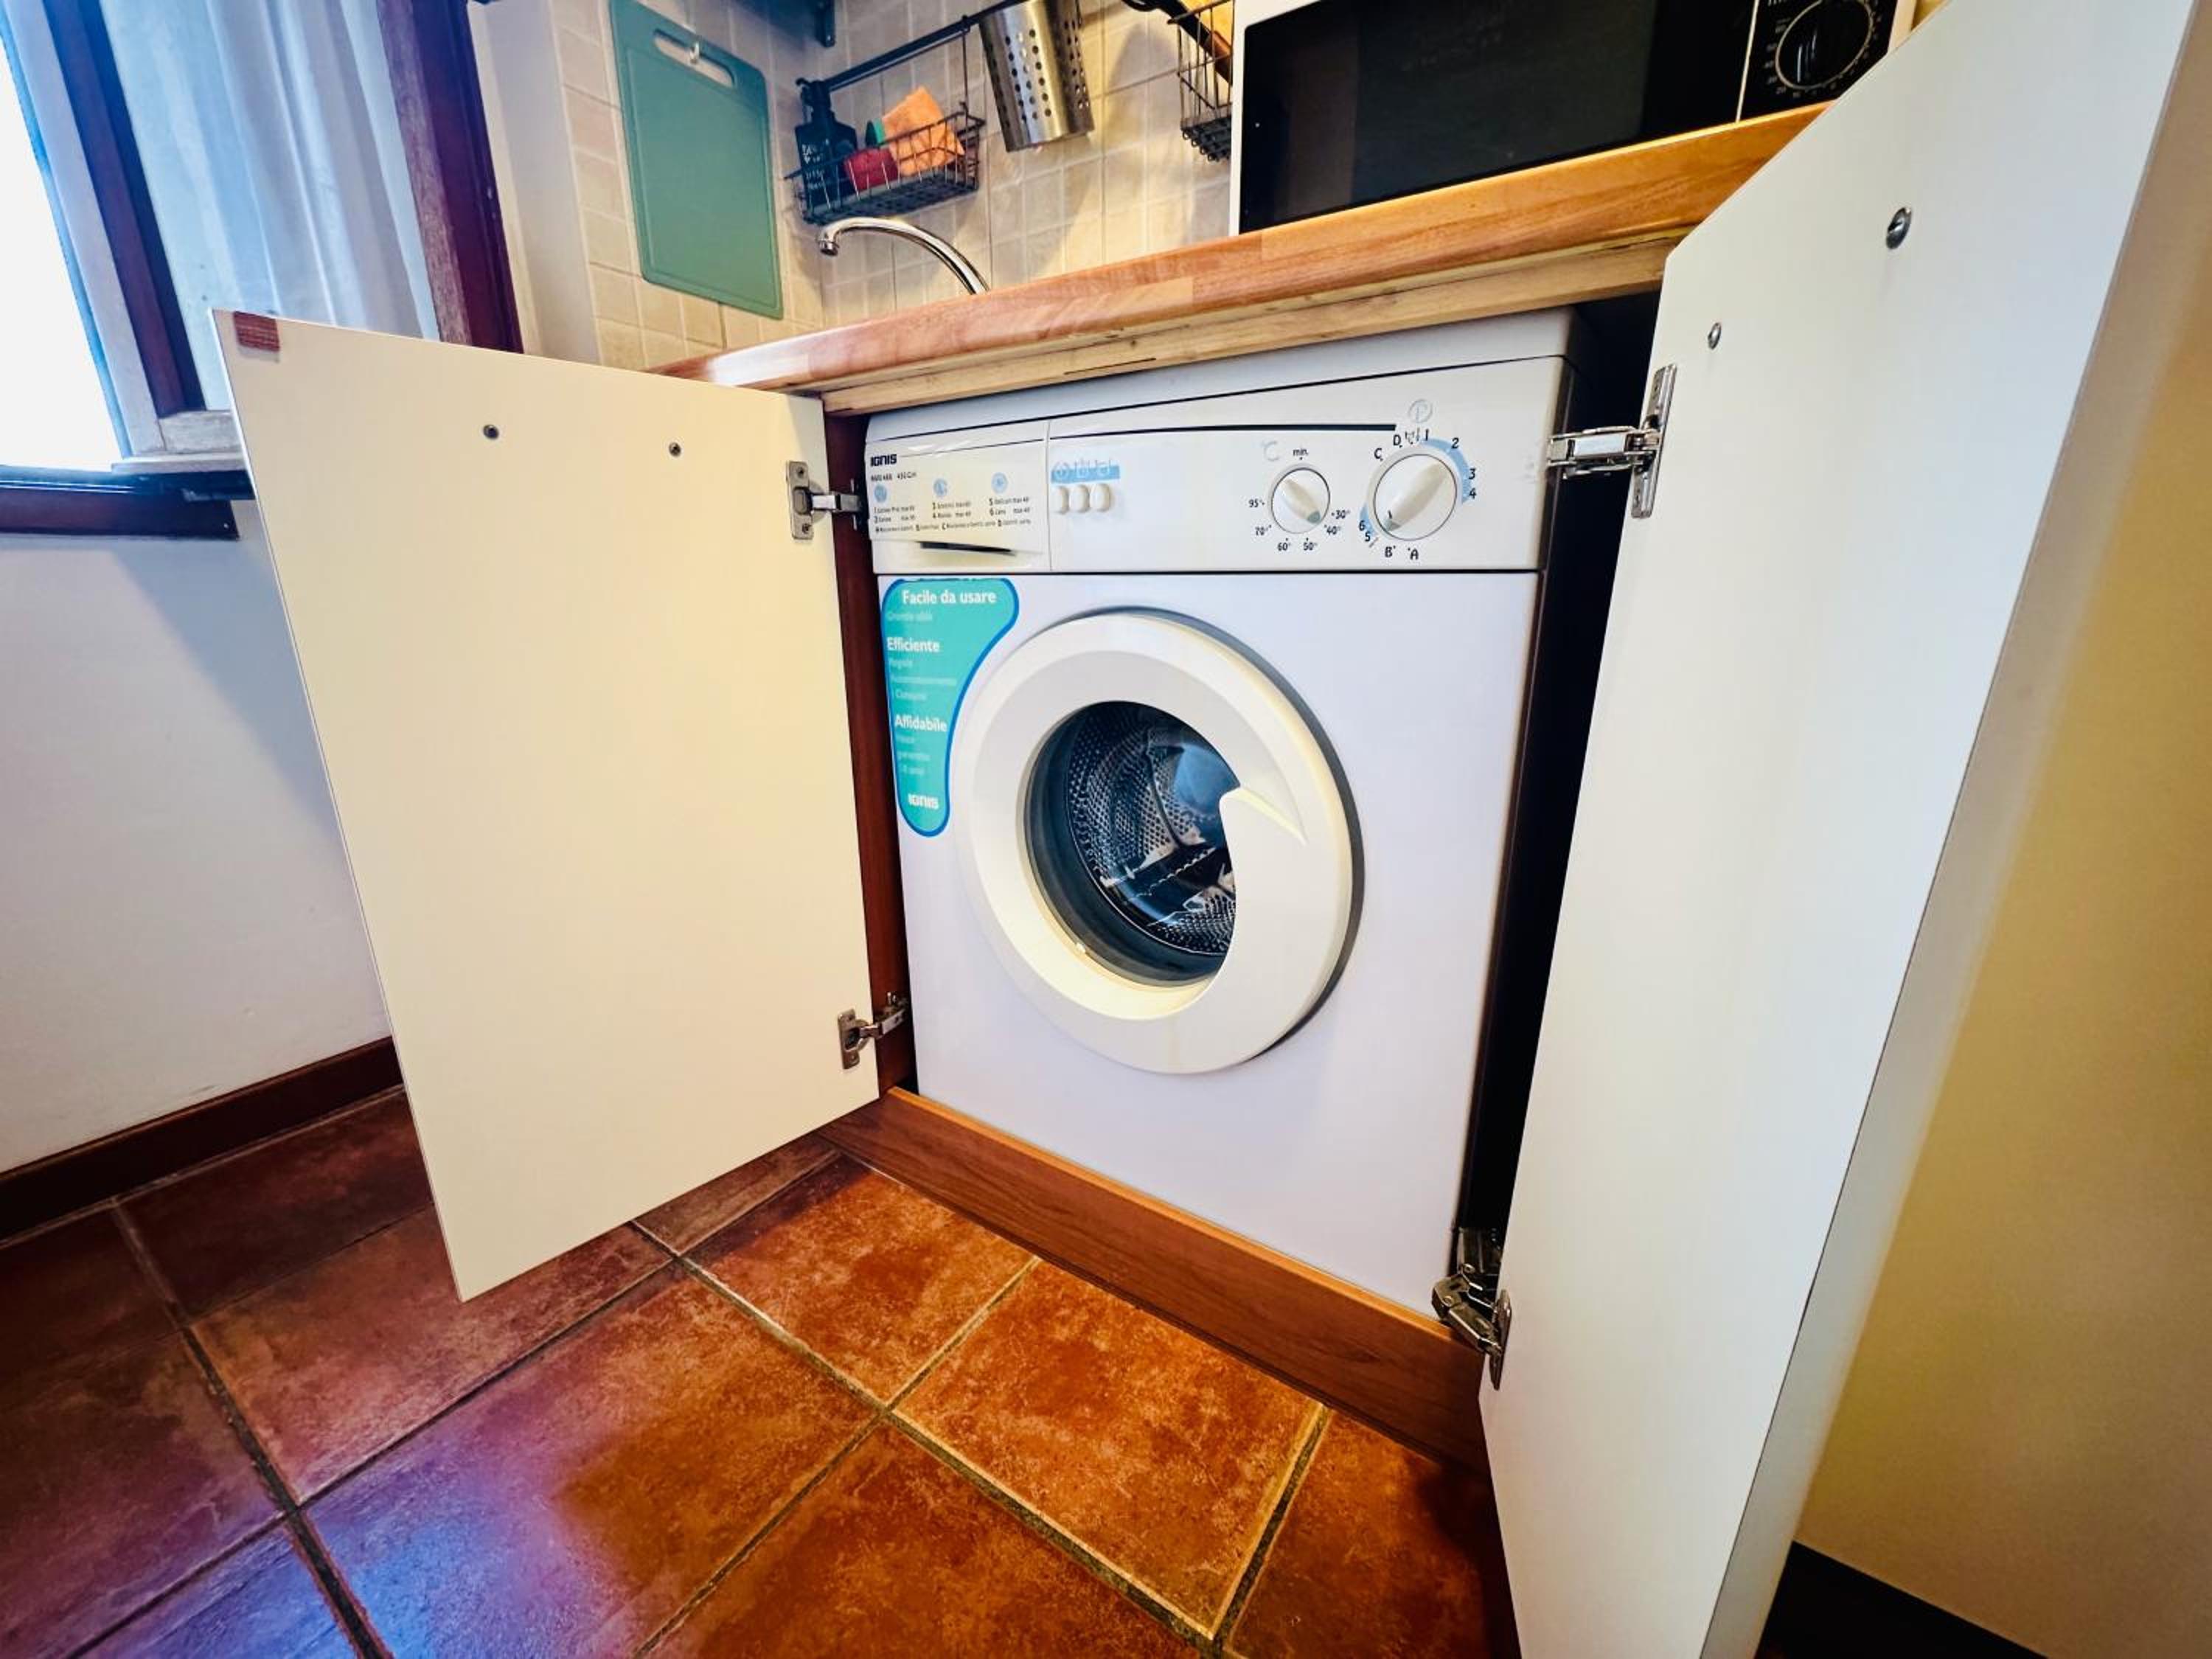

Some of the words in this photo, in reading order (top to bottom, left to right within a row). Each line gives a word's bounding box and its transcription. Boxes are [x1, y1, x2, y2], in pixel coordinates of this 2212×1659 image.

[1393, 435, 1402, 445] D
[1451, 437, 1459, 449] 2
[1293, 448, 1309, 456] min.
[1374, 448, 1382, 459] C
[870, 453, 897, 467] IGNIS
[1469, 468, 1476, 479] 3
[1469, 488, 1477, 499] 4
[1359, 521, 1366, 531] 6
[1365, 531, 1371, 542] 5
[1385, 546, 1393, 557] B
[1410, 549, 1419, 560] A
[902, 590, 937, 605] Facile
[940, 590, 956, 604] da
[960, 591, 997, 604] usare
[887, 636, 940, 653] Efficiente
[894, 714, 947, 732] Affidabile
